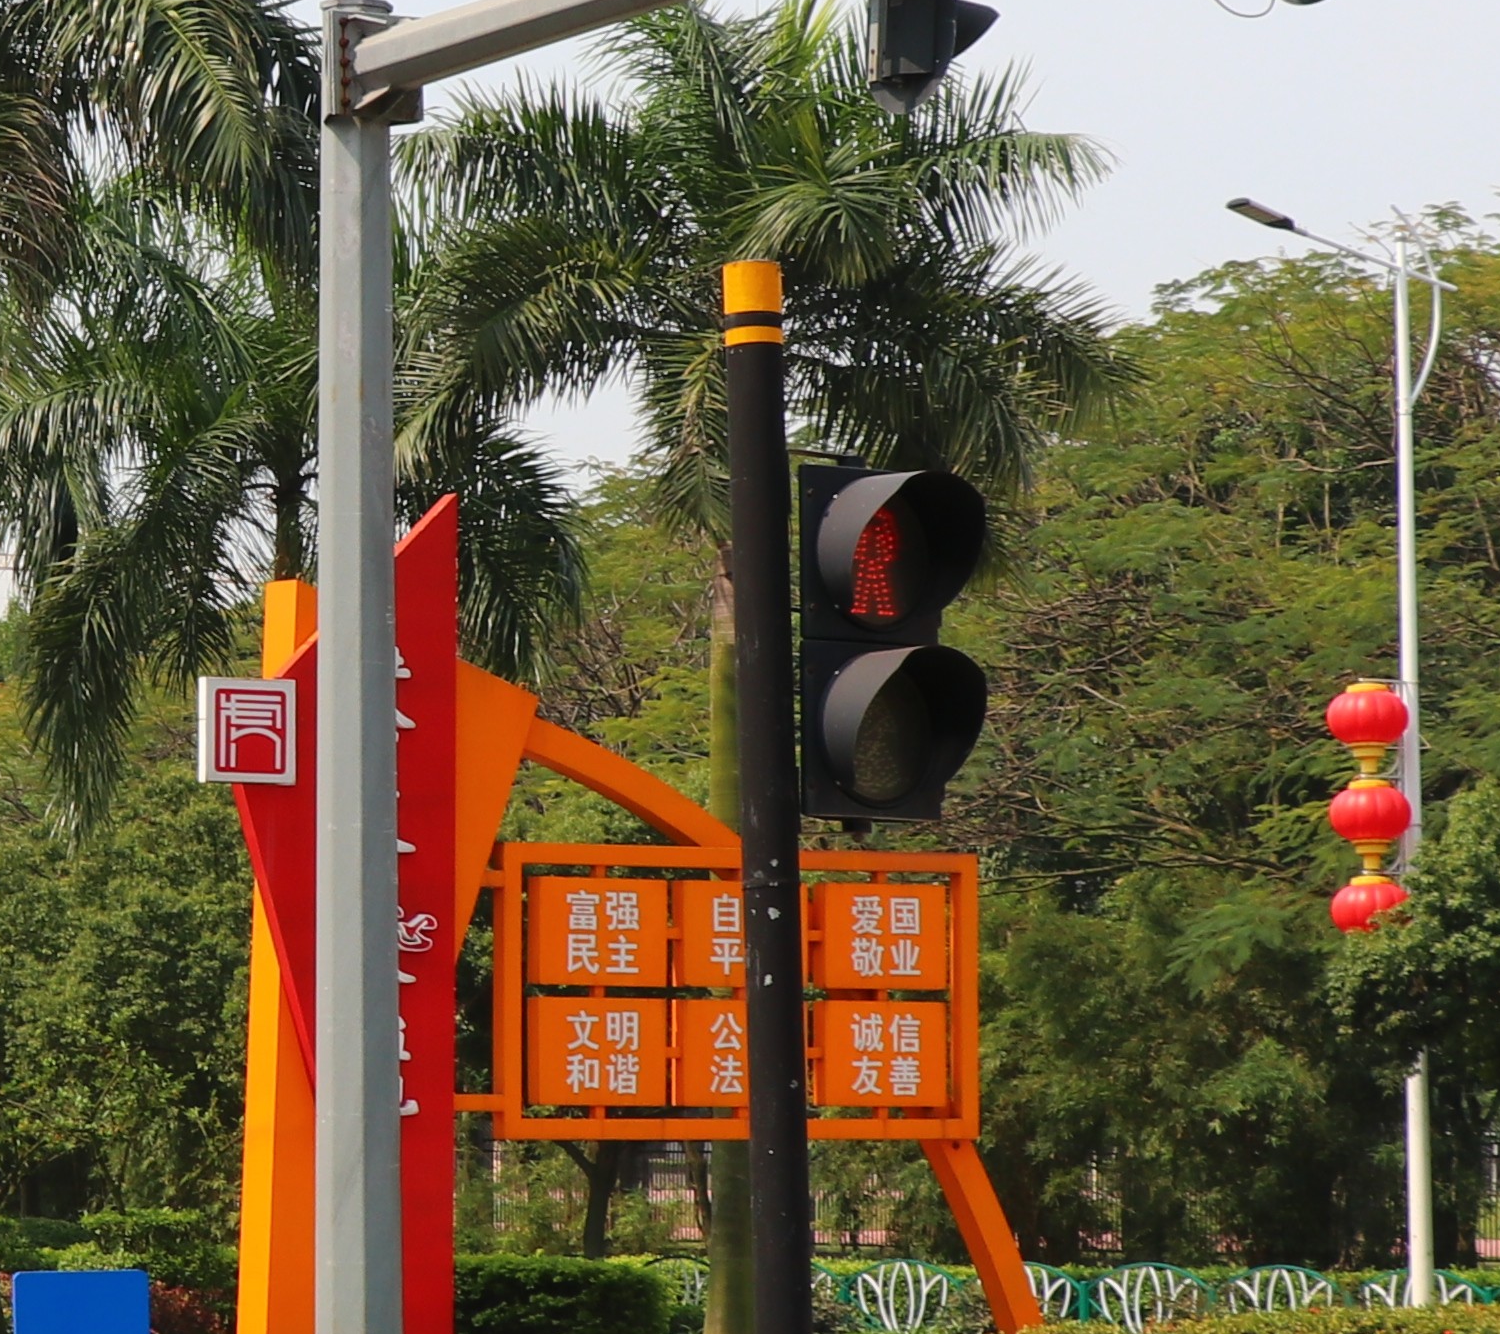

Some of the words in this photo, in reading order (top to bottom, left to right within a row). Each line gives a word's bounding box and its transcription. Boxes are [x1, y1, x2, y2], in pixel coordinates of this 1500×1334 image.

[566, 890, 639, 931] 富强
[712, 893, 741, 933] 自
[851, 896, 921, 935] 爱国
[567, 933, 639, 974] 民主
[710, 938, 744, 975] 平
[851, 938, 921, 977] 敬业
[566, 1010, 639, 1051] 文明
[710, 1013, 743, 1050] 公
[851, 1013, 921, 1053] 诚信
[566, 1054, 639, 1094] 和谐
[710, 1055, 743, 1094] 法
[851, 1056, 921, 1096] 友善
